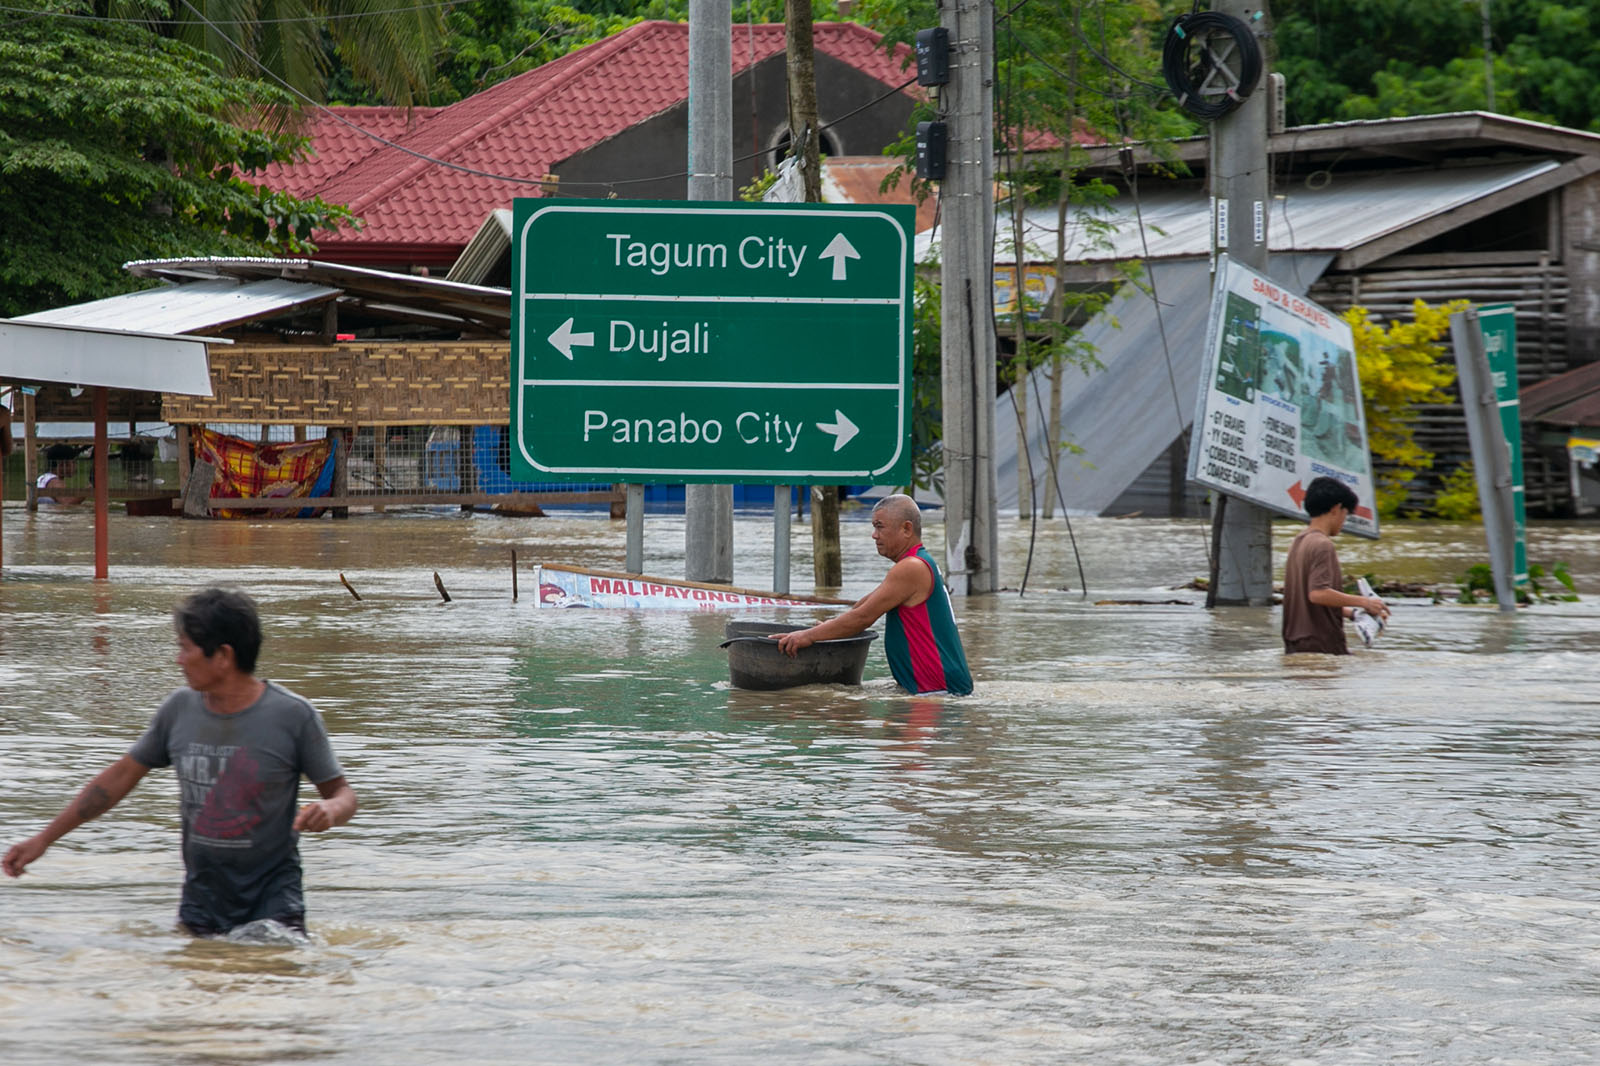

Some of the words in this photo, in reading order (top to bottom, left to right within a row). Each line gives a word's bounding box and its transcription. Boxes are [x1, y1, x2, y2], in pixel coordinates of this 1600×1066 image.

[606, 233, 727, 275] Tagum
[738, 236, 807, 277] City
[1252, 278, 1280, 302] SAND
[1292, 299, 1331, 329] GRAVEL
[609, 320, 709, 362] Dujali
[584, 410, 722, 443] Panabo
[736, 411, 803, 452] City
[1222, 432, 1244, 452] GRAVEL
[1224, 414, 1246, 435] GRAVEL
[590, 577, 739, 603] MALIPAYONG
